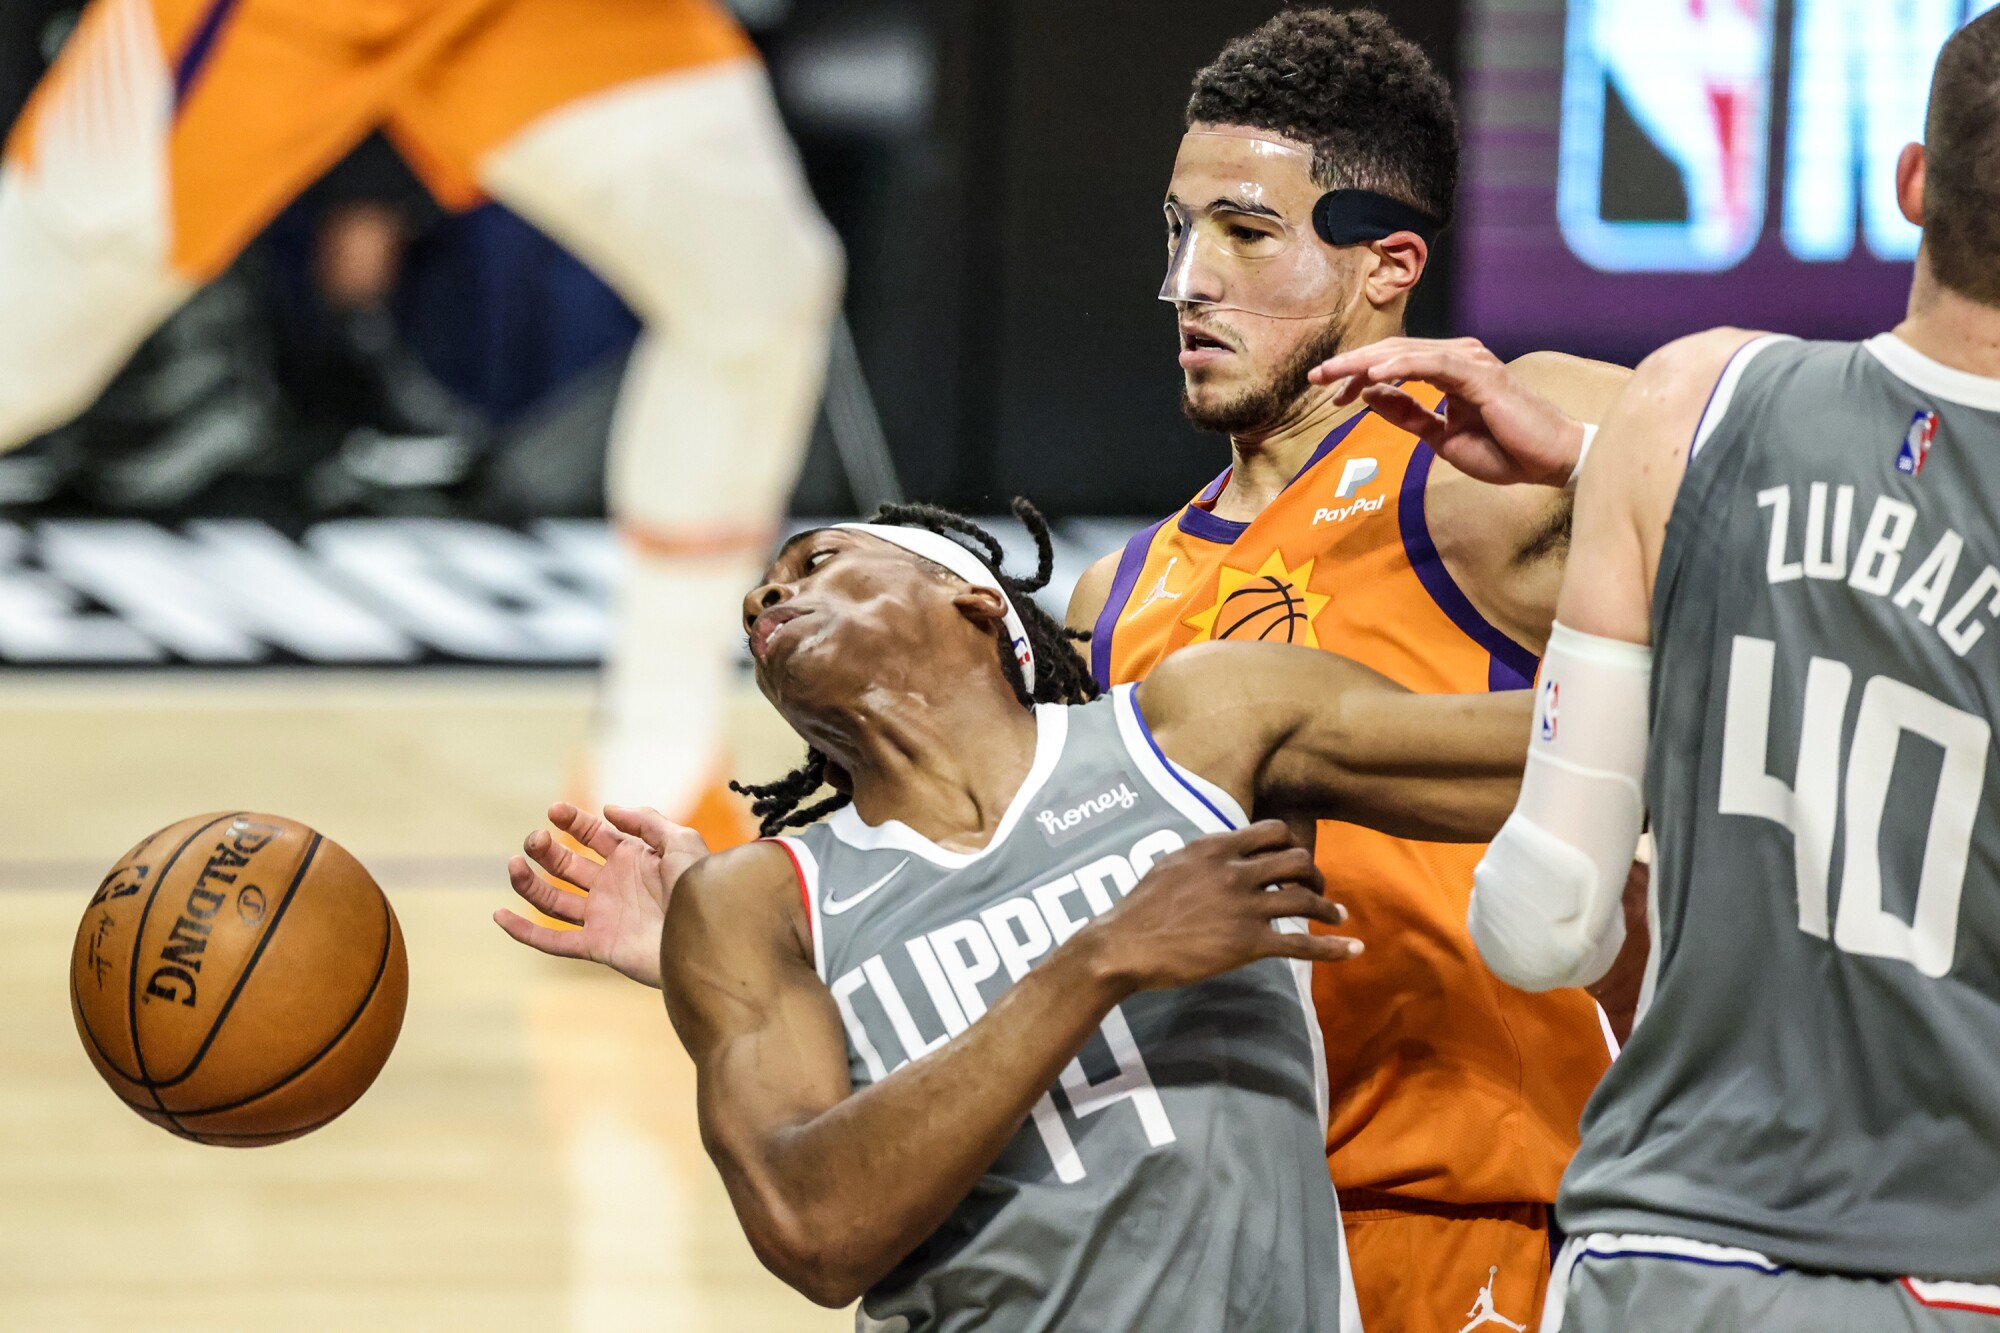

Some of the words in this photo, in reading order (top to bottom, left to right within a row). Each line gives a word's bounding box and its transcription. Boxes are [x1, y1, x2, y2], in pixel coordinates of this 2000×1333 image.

[1312, 494, 1386, 526] PayPal
[1757, 481, 2000, 657] ZUBAC
[1036, 782, 1139, 835] honey
[1718, 635, 1991, 978] 40
